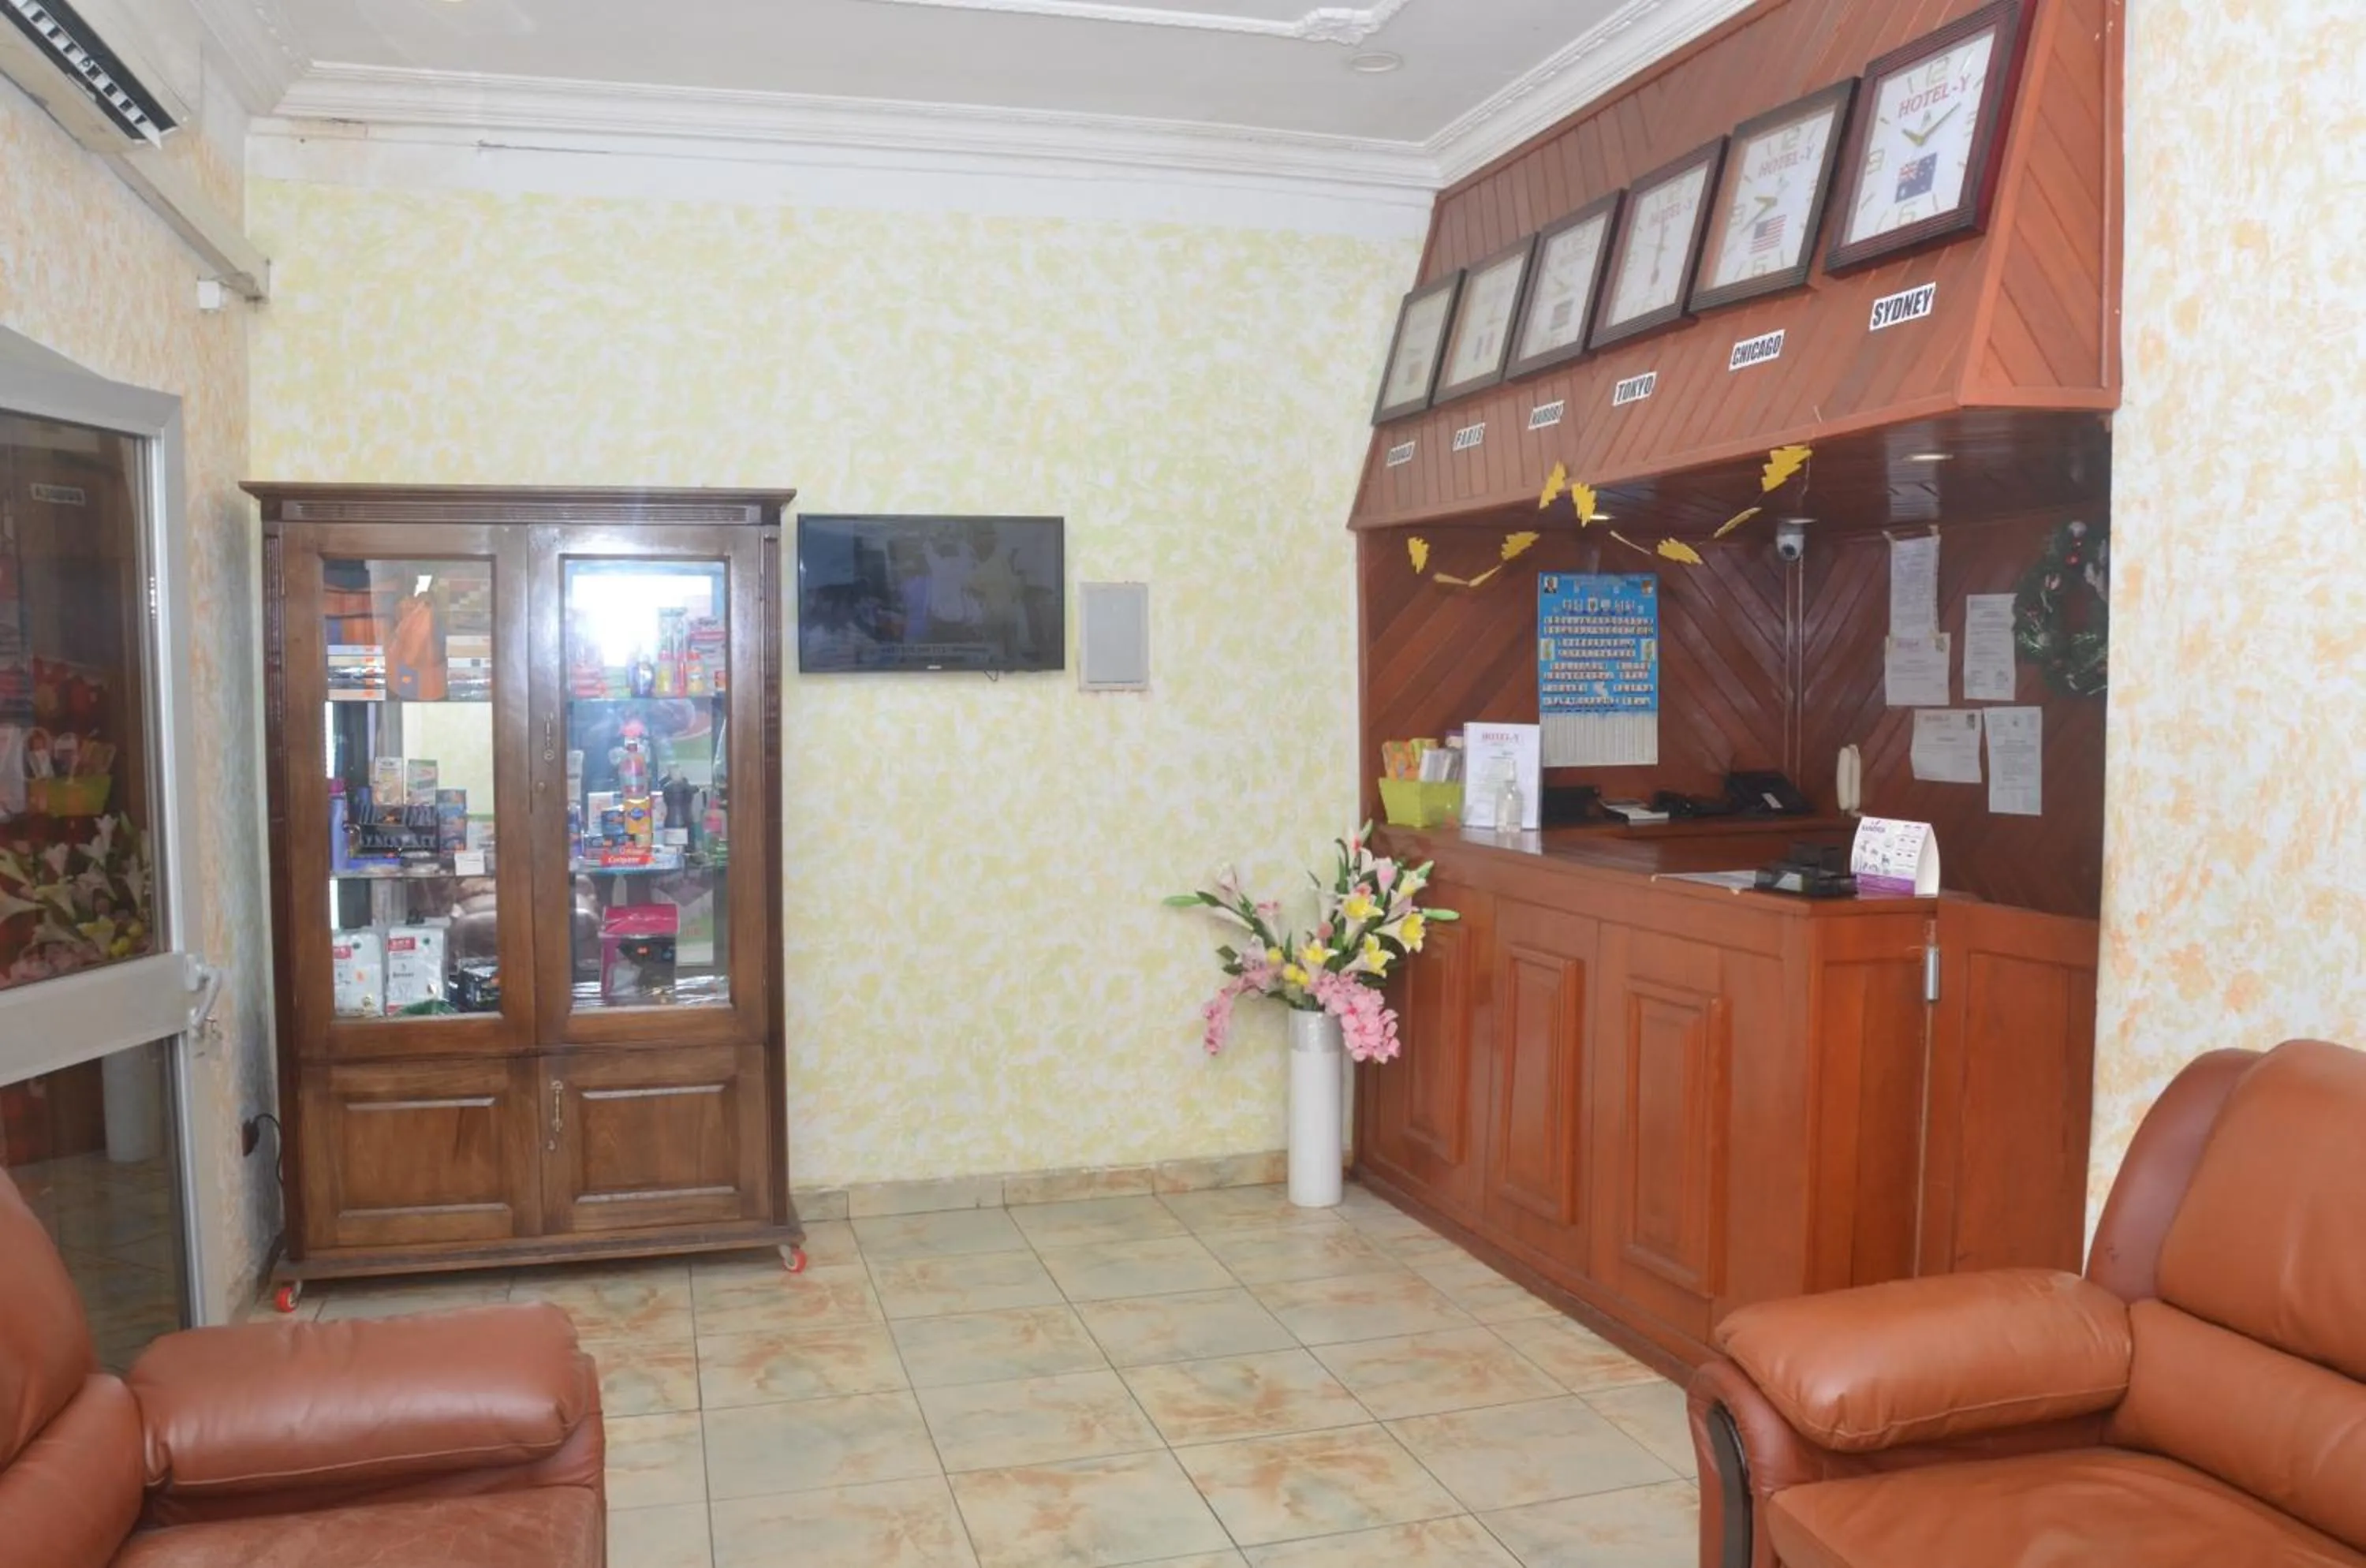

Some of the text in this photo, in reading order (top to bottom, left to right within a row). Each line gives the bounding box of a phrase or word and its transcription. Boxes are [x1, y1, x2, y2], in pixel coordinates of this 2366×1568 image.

[1898, 73, 1971, 119] HOTEL-Y
[1873, 287, 1932, 327] SYDNEY
[1732, 334, 1781, 366] CHICAGO
[1617, 375, 1653, 401] TOKYO
